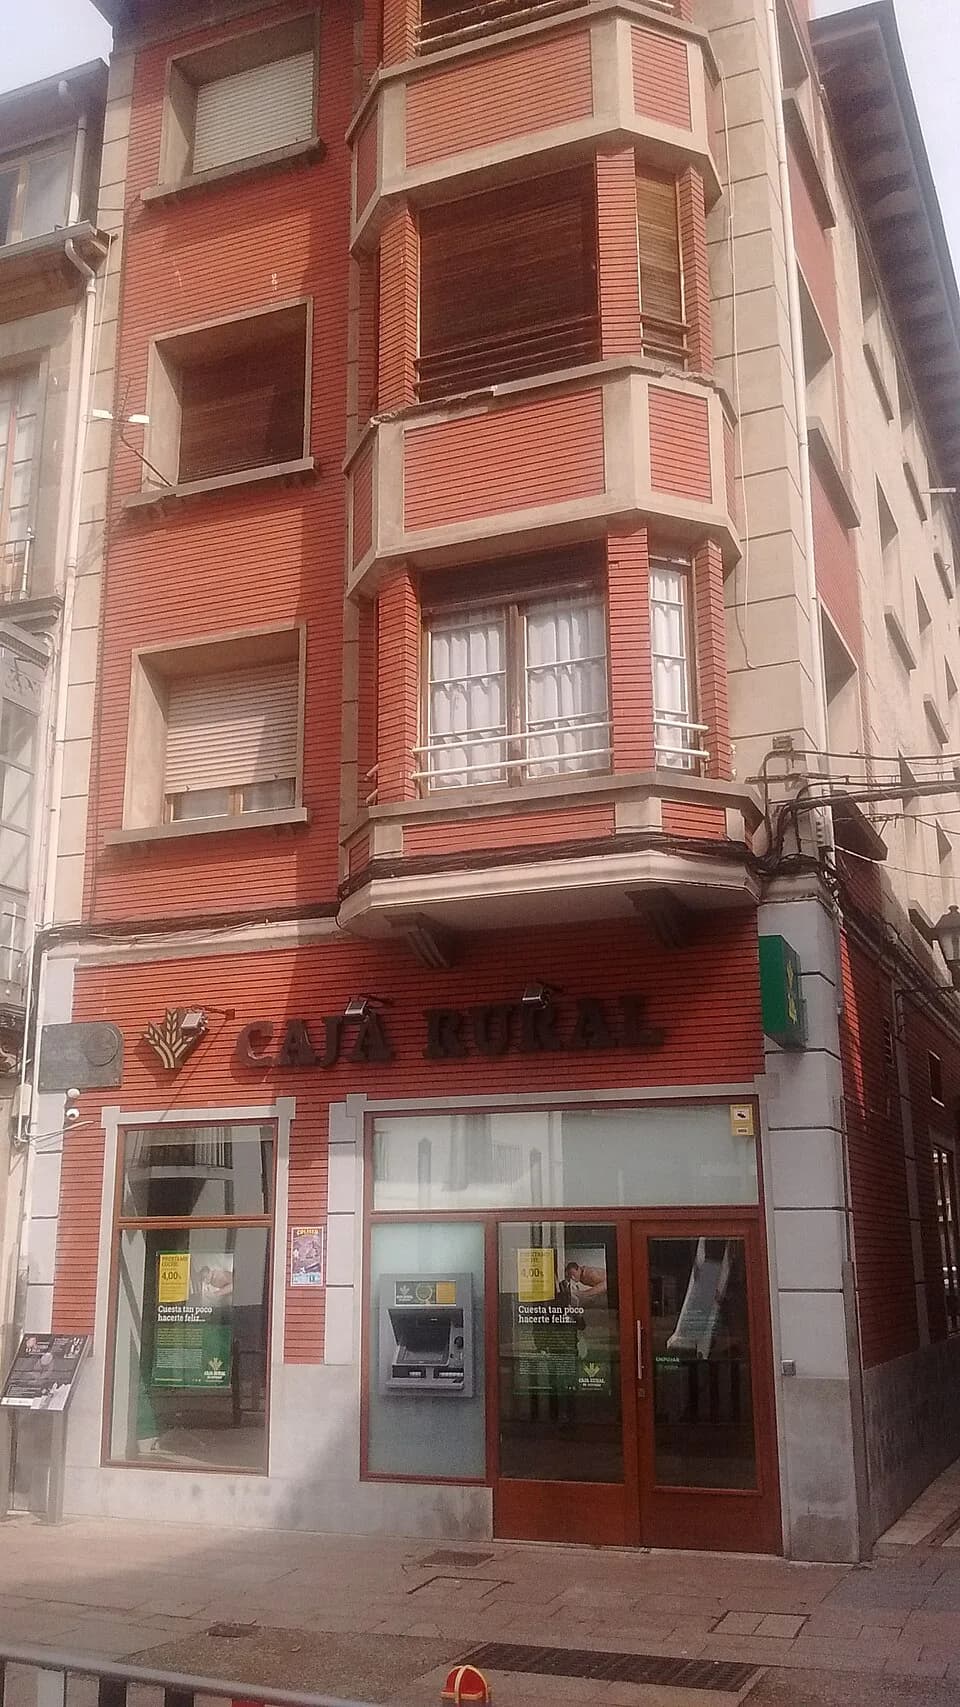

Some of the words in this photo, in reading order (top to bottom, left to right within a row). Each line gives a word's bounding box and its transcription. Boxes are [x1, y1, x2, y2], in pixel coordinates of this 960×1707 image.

[235, 1012, 396, 1069] CAJA
[422, 996, 666, 1060] RURAL
[158, 1305, 182, 1313] Cuesta
[195, 1306, 213, 1315] poco
[518, 1305, 547, 1314] Cuesta
[548, 1306, 562, 1314] tan
[564, 1306, 584, 1316] poco
[157, 1313, 183, 1322] hacerte
[518, 1314, 550, 1324] hacerte
